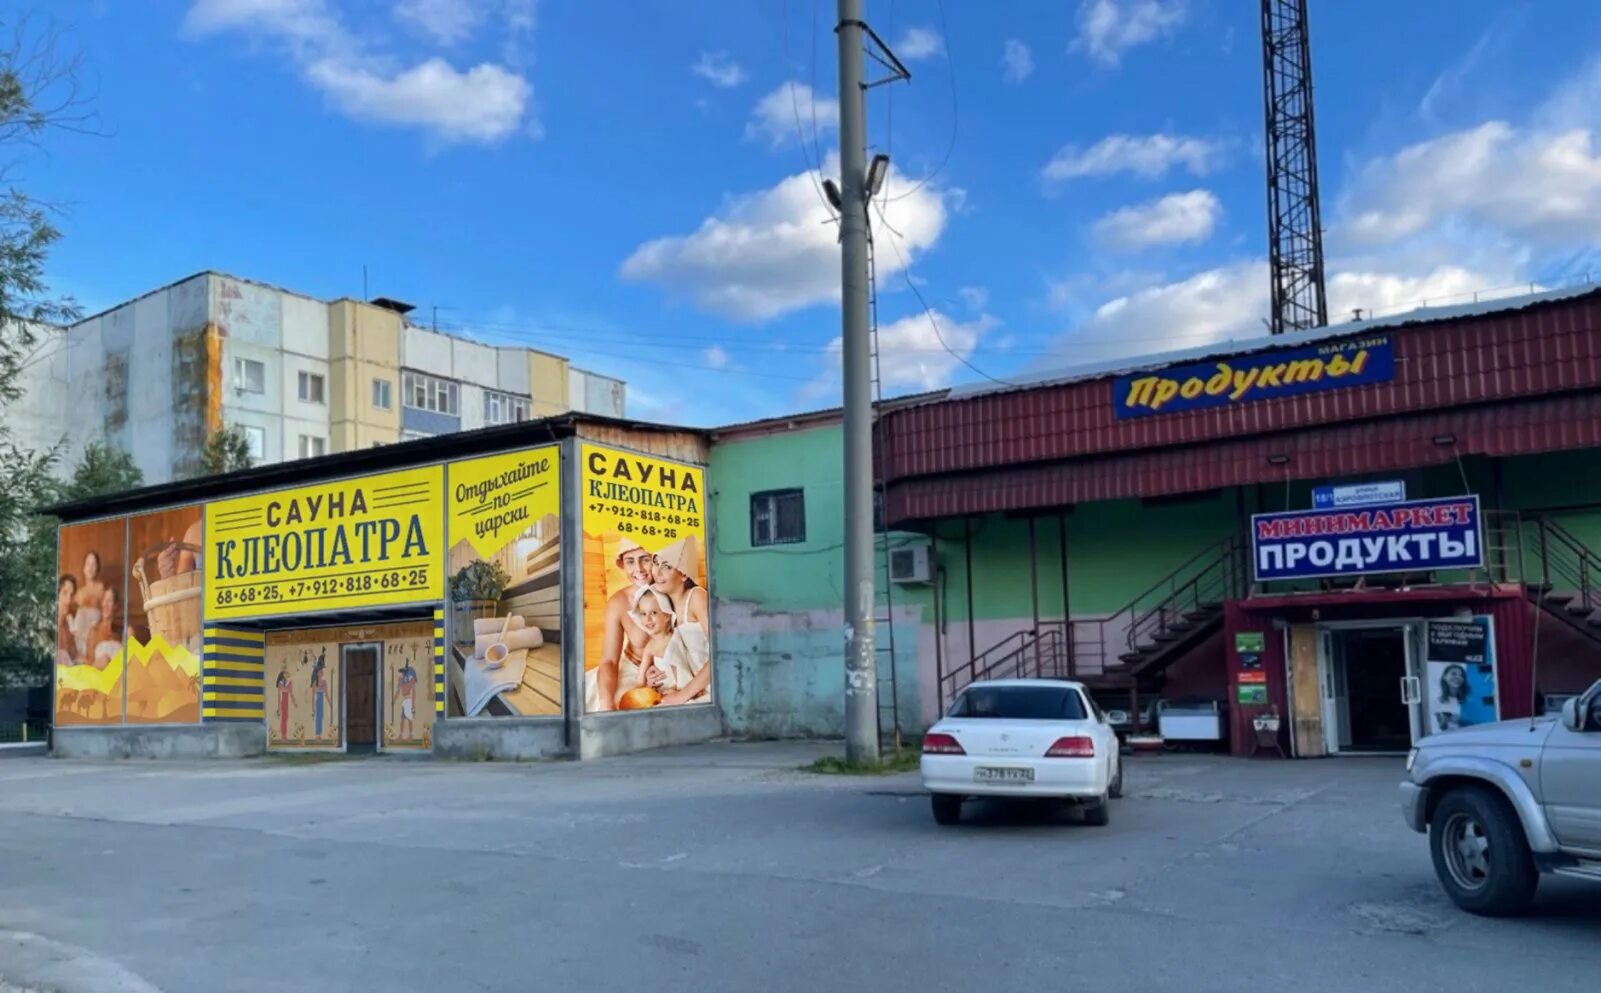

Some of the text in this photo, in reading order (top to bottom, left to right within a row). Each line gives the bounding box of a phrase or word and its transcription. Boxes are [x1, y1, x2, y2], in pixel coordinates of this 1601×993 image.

[1318, 336, 1388, 355] МАГАЗИН
[1125, 350, 1370, 410] Продукты
[456, 458, 550, 504] Отдыхайте
[588, 452, 698, 493] САУНА
[266, 488, 368, 528] САУНА
[492, 492, 511, 510] по
[588, 479, 698, 513] КЛЕОПАТРА
[475, 505, 529, 539] царски
[1257, 503, 1472, 540] МИНИМАРКЕТ
[215, 514, 430, 580] КЛЕОПАТРА
[1259, 529, 1476, 571] ПРОДУКТЫ
